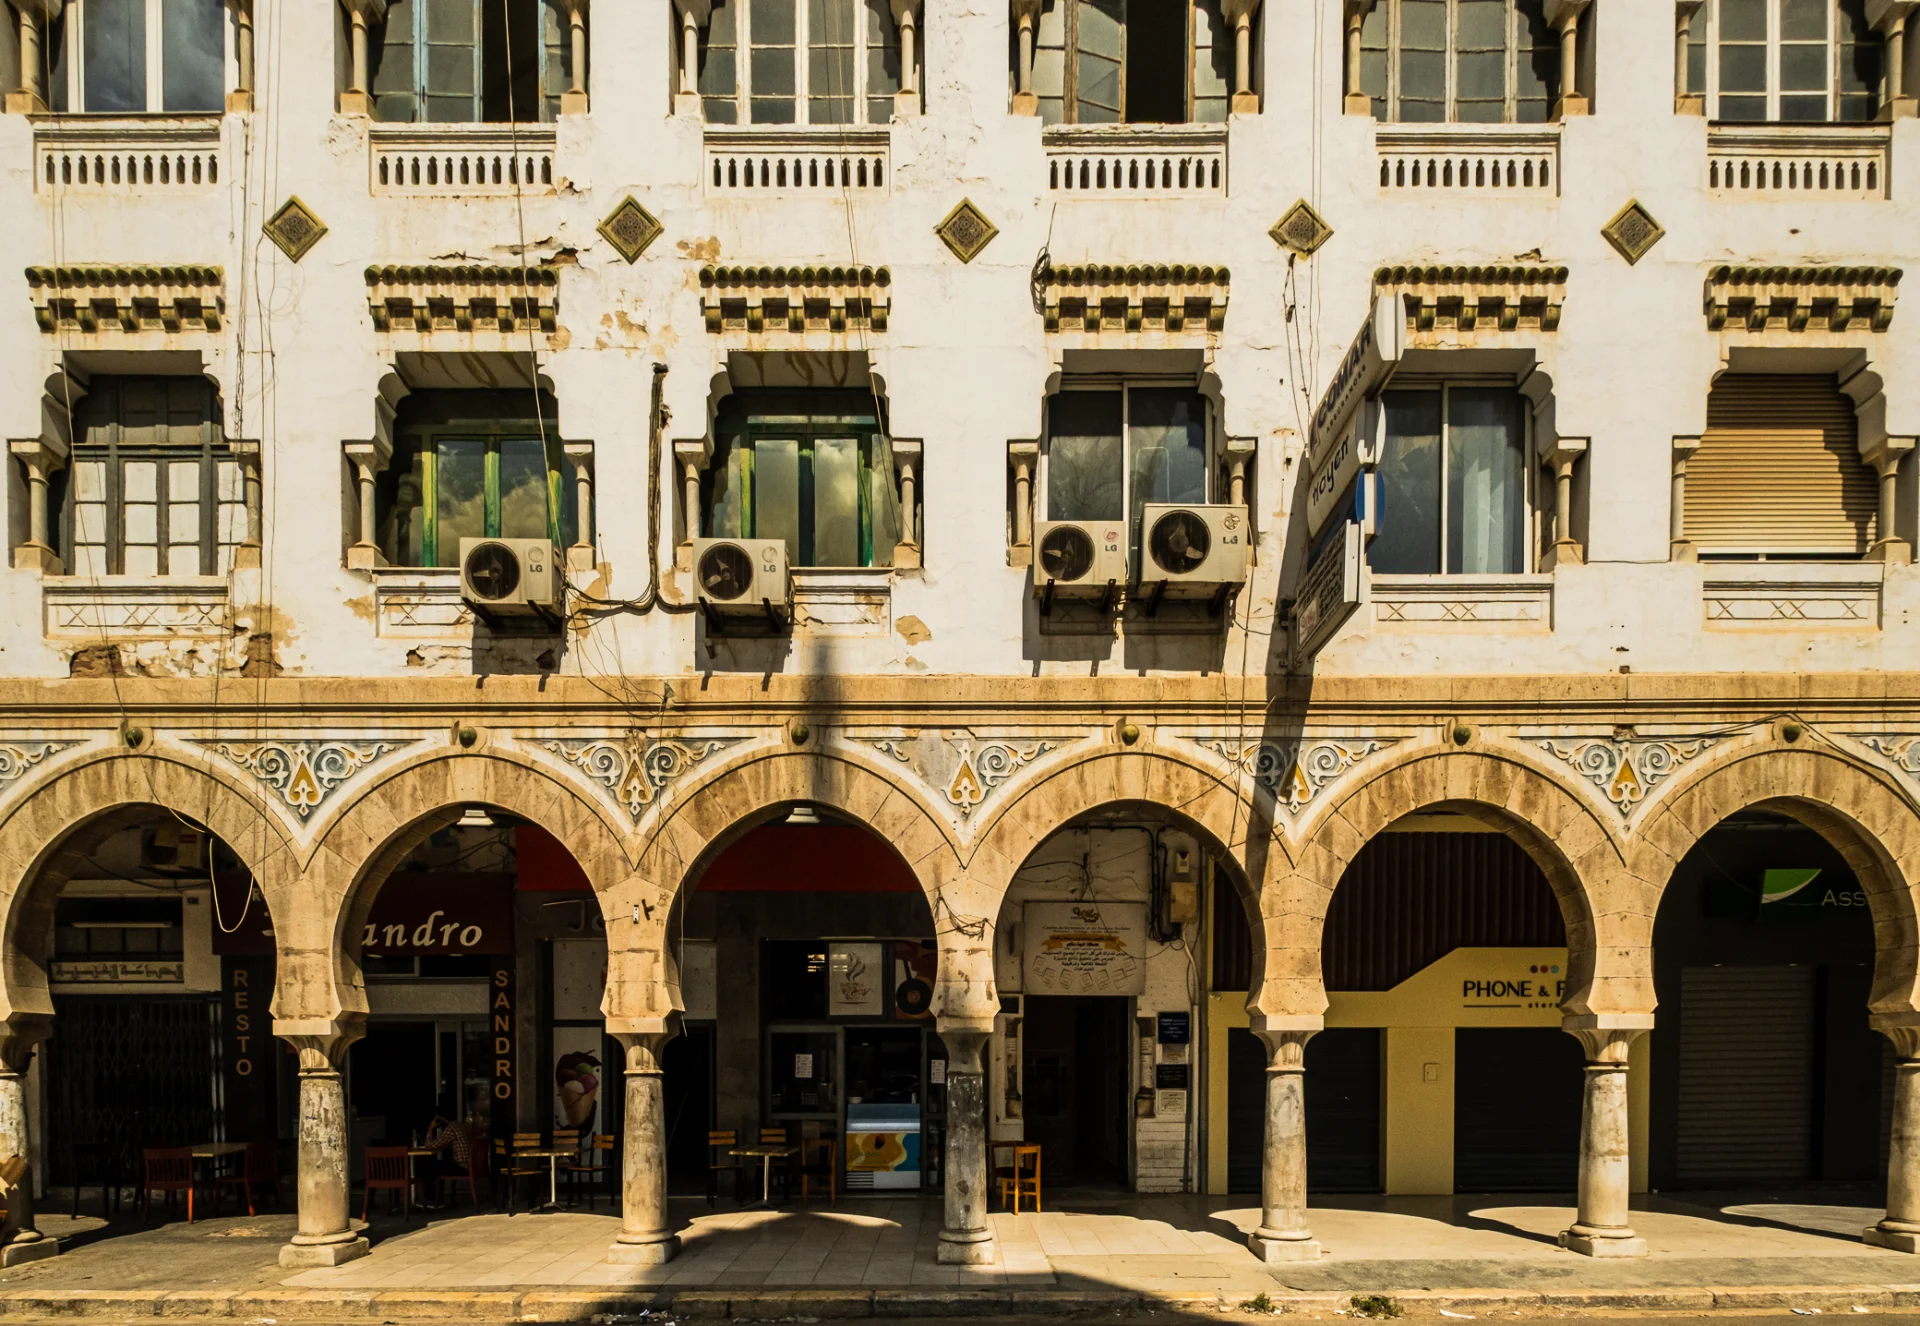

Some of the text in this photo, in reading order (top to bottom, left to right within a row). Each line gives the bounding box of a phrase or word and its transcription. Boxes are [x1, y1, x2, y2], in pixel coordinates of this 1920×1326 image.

[1318, 319, 1372, 429] COMAR
[1104, 544, 1118, 552] LG
[1222, 535, 1238, 545] LG
[529, 564, 543, 573] LG
[763, 564, 776, 573] LG
[361, 910, 483, 948] andro
[1463, 980, 1532, 997] PHONE
[1538, 985, 1550, 997] &
[233, 969, 253, 1076] RESTO
[494, 969, 512, 1100] SANDRO
